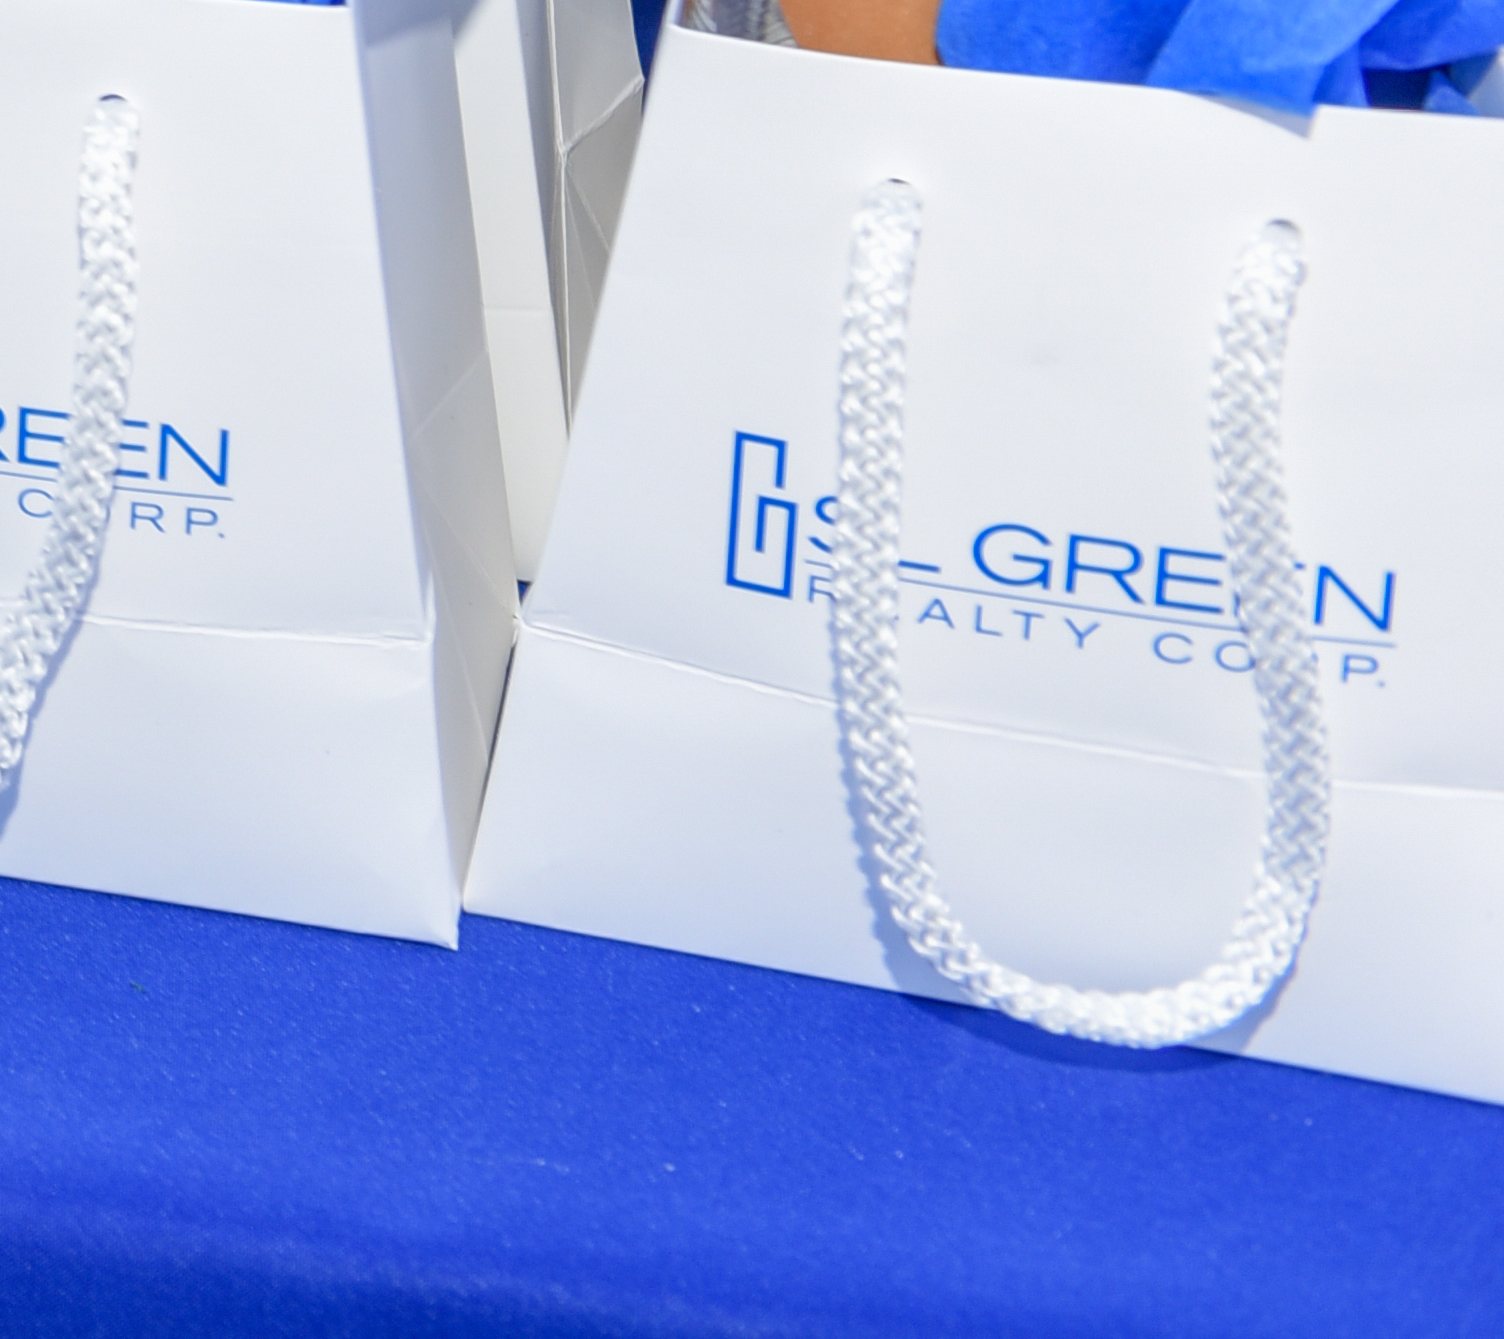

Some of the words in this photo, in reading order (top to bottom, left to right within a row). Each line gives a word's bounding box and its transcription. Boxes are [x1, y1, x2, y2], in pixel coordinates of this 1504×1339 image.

[17, 487, 226, 539] CRP.
[971, 523, 1397, 633] GREN
[1152, 632, 1388, 688] COP.
